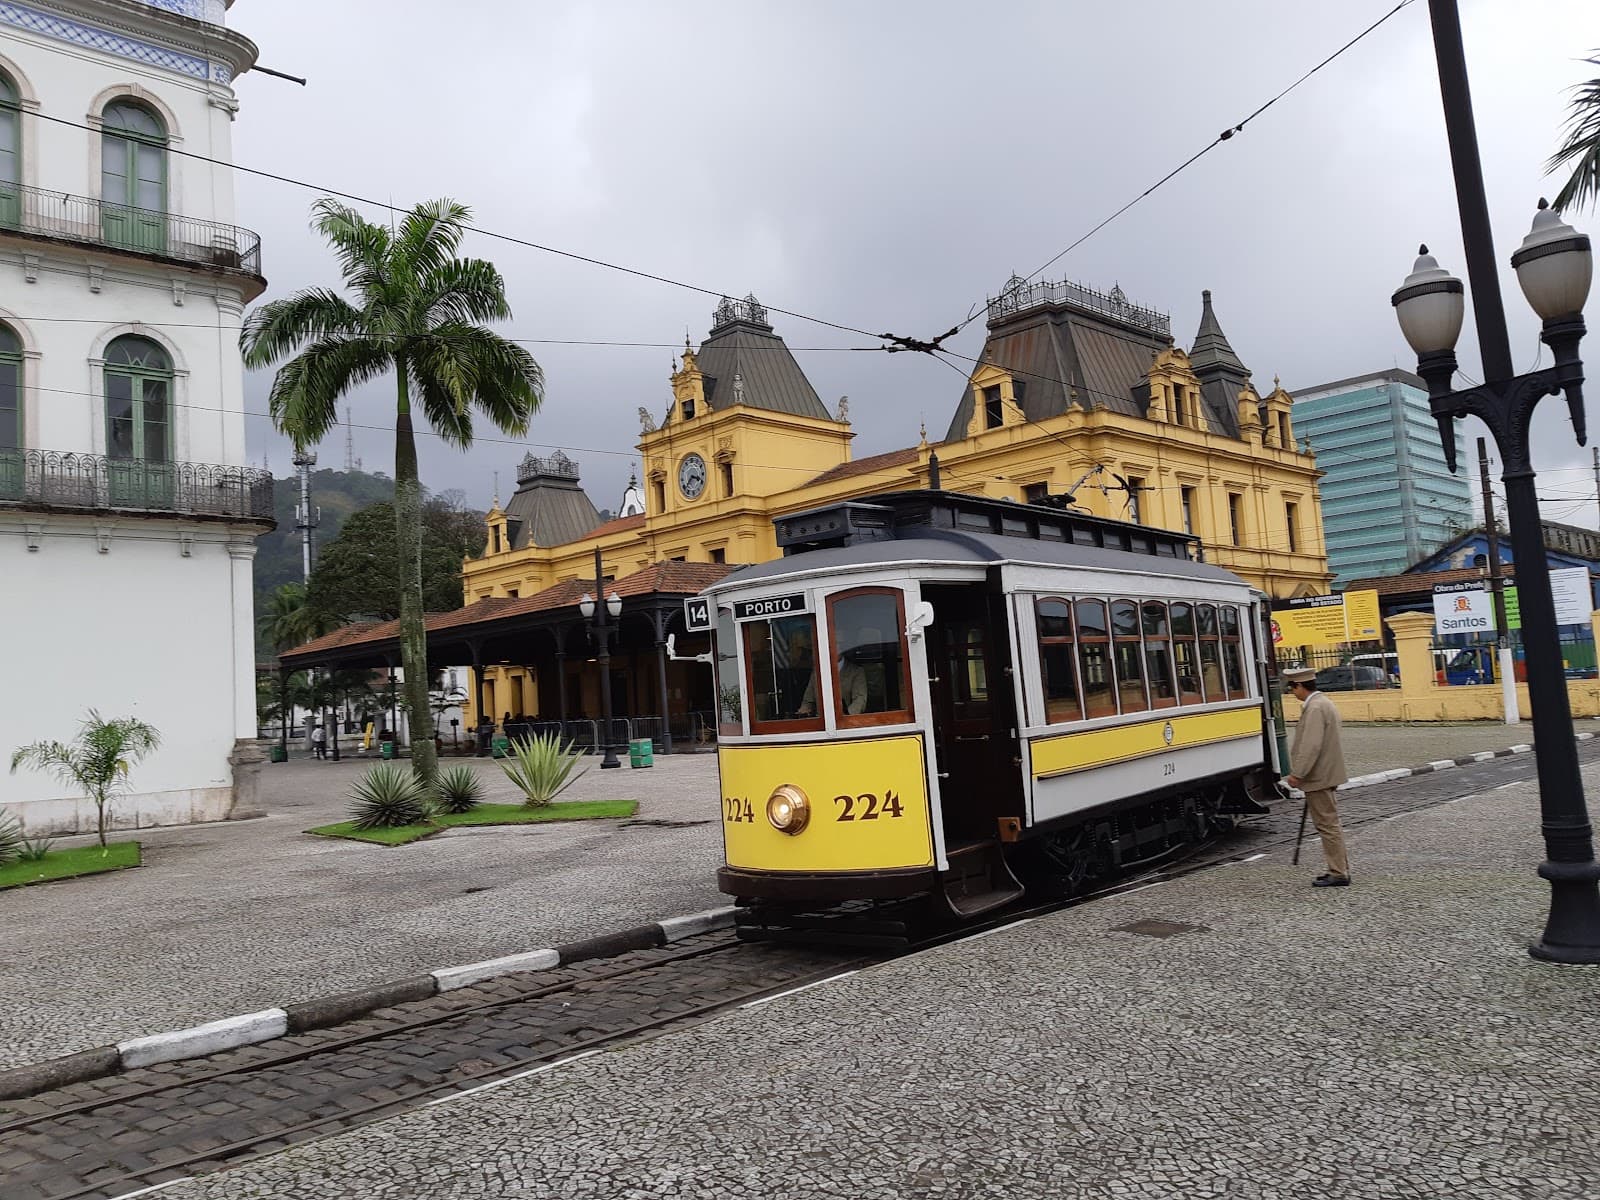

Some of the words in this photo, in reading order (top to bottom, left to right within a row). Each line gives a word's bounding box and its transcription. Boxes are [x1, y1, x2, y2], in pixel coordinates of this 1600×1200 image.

[1434, 584, 1454, 593] Obra
[1454, 583, 1464, 591] da
[1464, 581, 1485, 590] Prefe
[690, 605, 708, 623] 14
[745, 599, 792, 616] PORTO
[1441, 616, 1488, 630] Santos
[1163, 761, 1176, 777] 224
[725, 796, 755, 824] 224
[833, 789, 905, 822] 224
